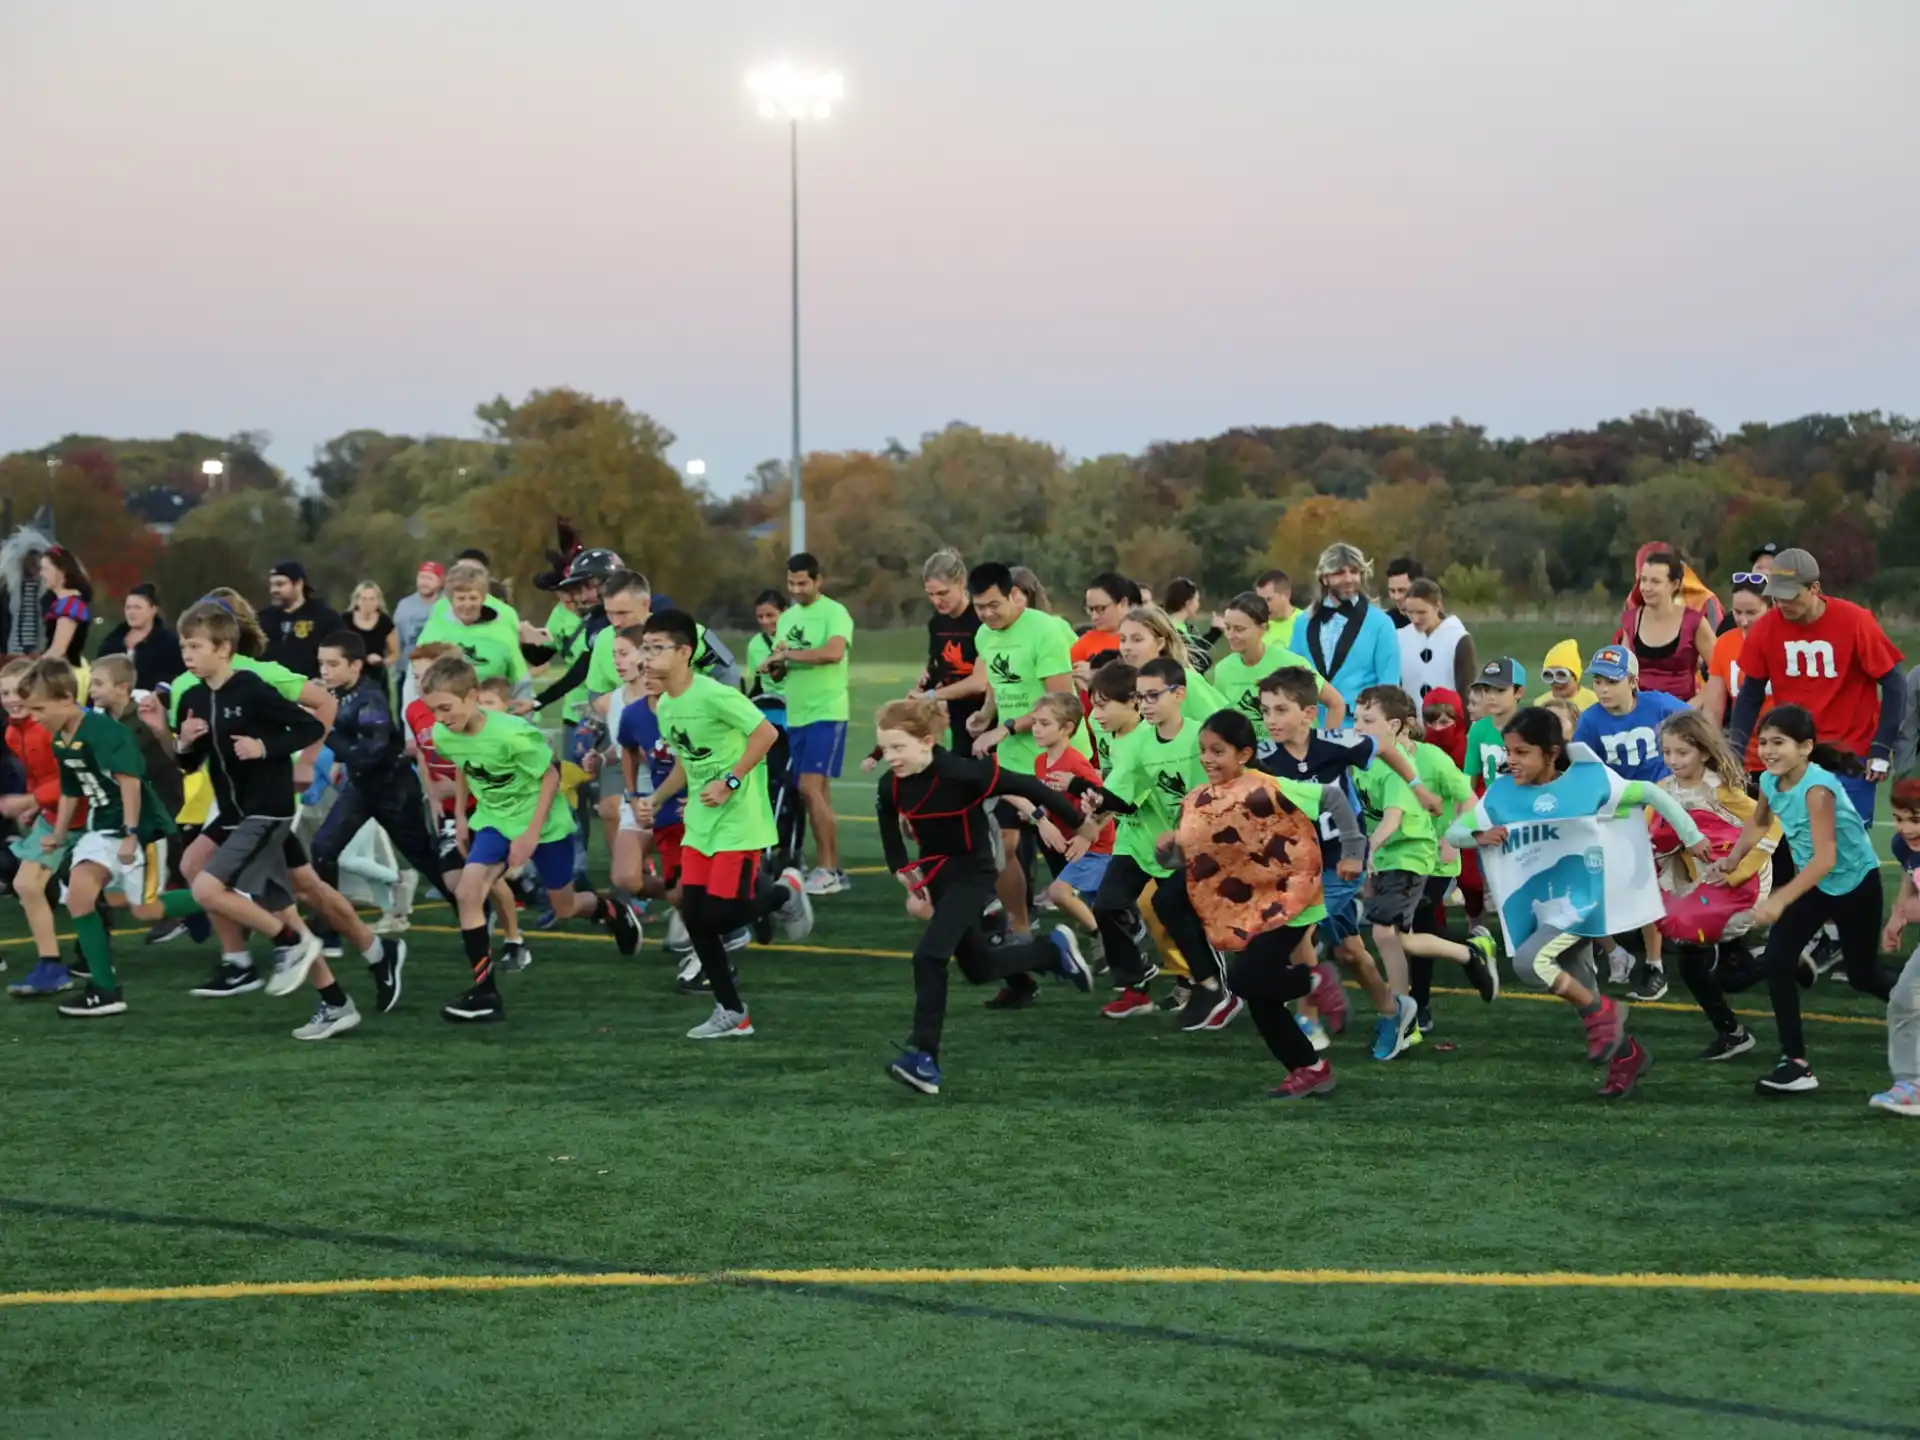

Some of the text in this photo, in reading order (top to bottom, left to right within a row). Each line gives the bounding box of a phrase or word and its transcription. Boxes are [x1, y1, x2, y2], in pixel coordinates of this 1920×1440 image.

[1784, 640, 1838, 679] m
[1601, 726, 1659, 766] m
[1502, 823, 1560, 855] Milk
